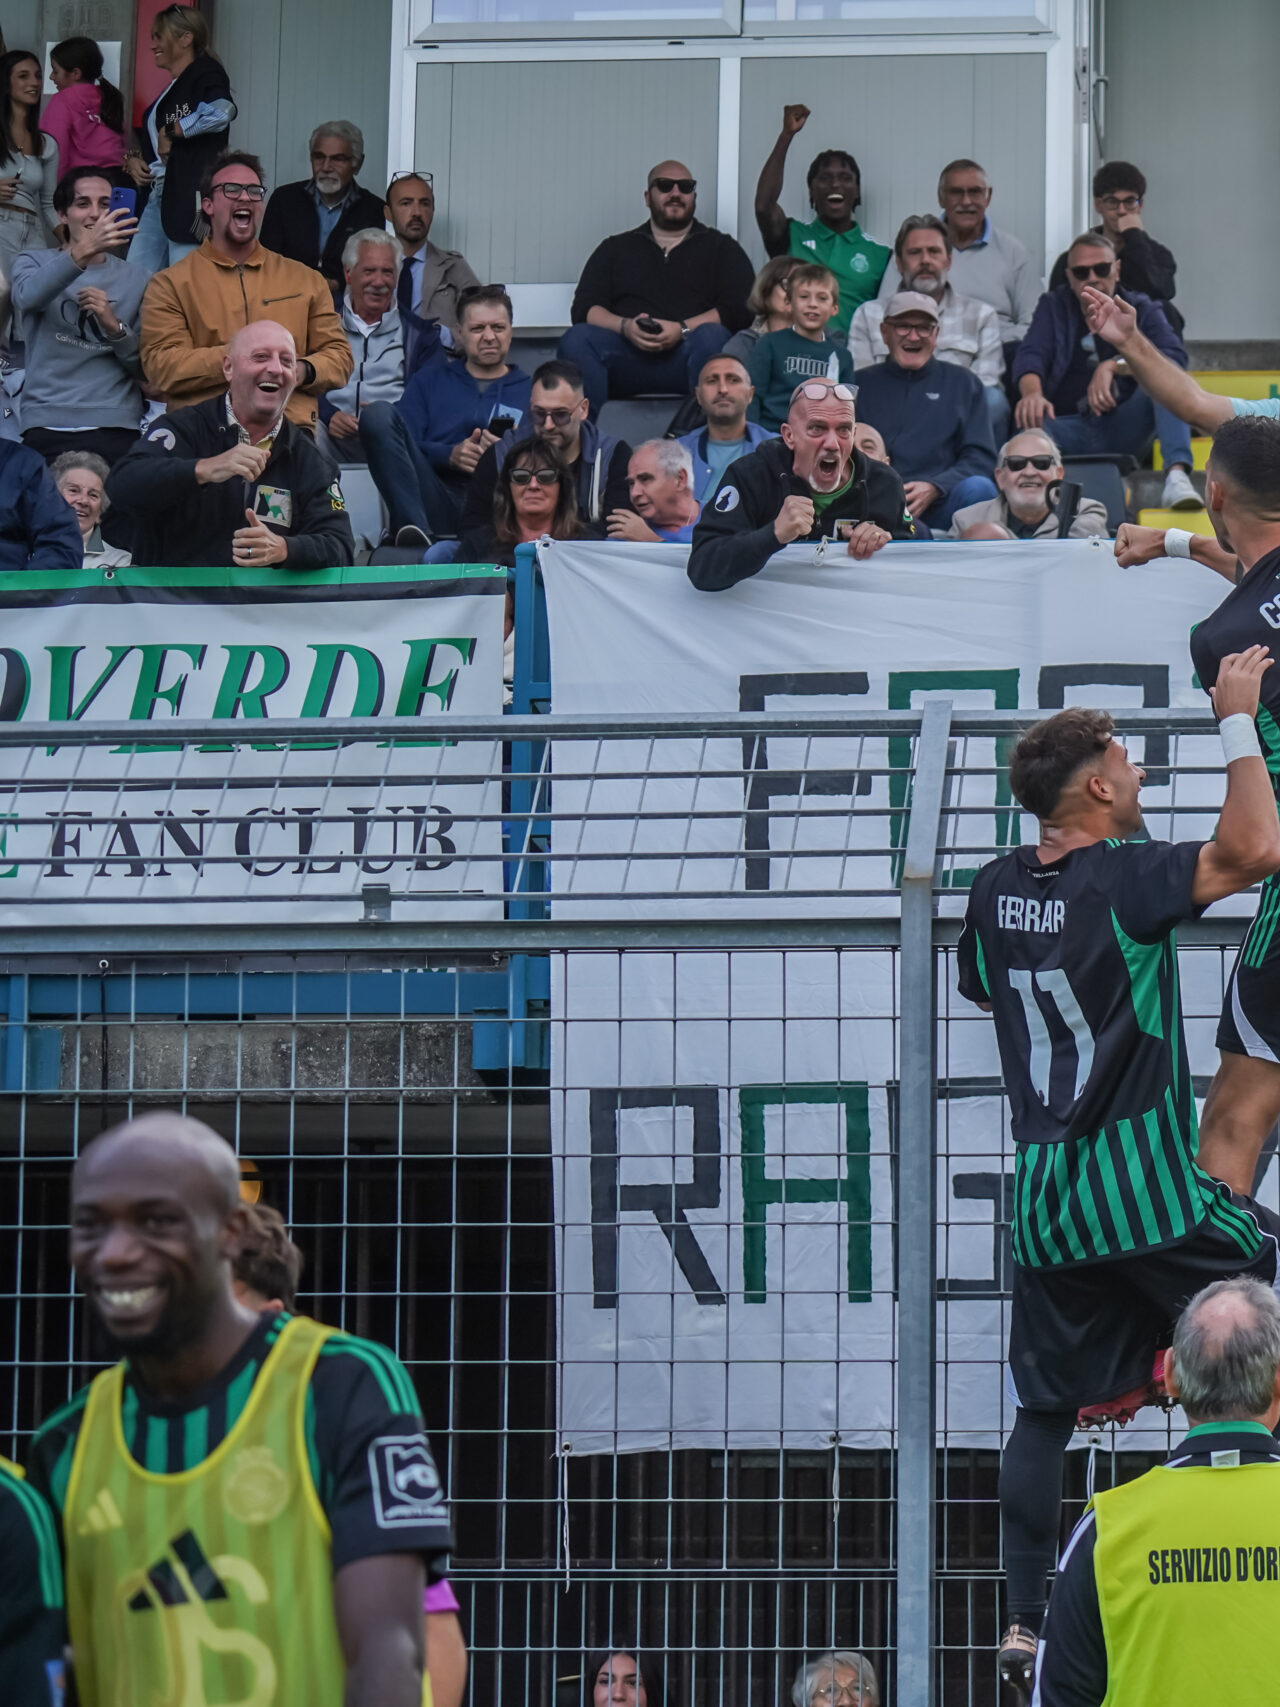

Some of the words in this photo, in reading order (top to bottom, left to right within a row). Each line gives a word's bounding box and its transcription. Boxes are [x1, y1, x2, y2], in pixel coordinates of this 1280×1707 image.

[787, 355, 830, 376] PUM
[44, 809, 210, 877] FAN
[234, 805, 457, 877] CLUB
[997, 895, 1068, 933] FERRAR
[1148, 1547, 1231, 1585] SERVIZIO
